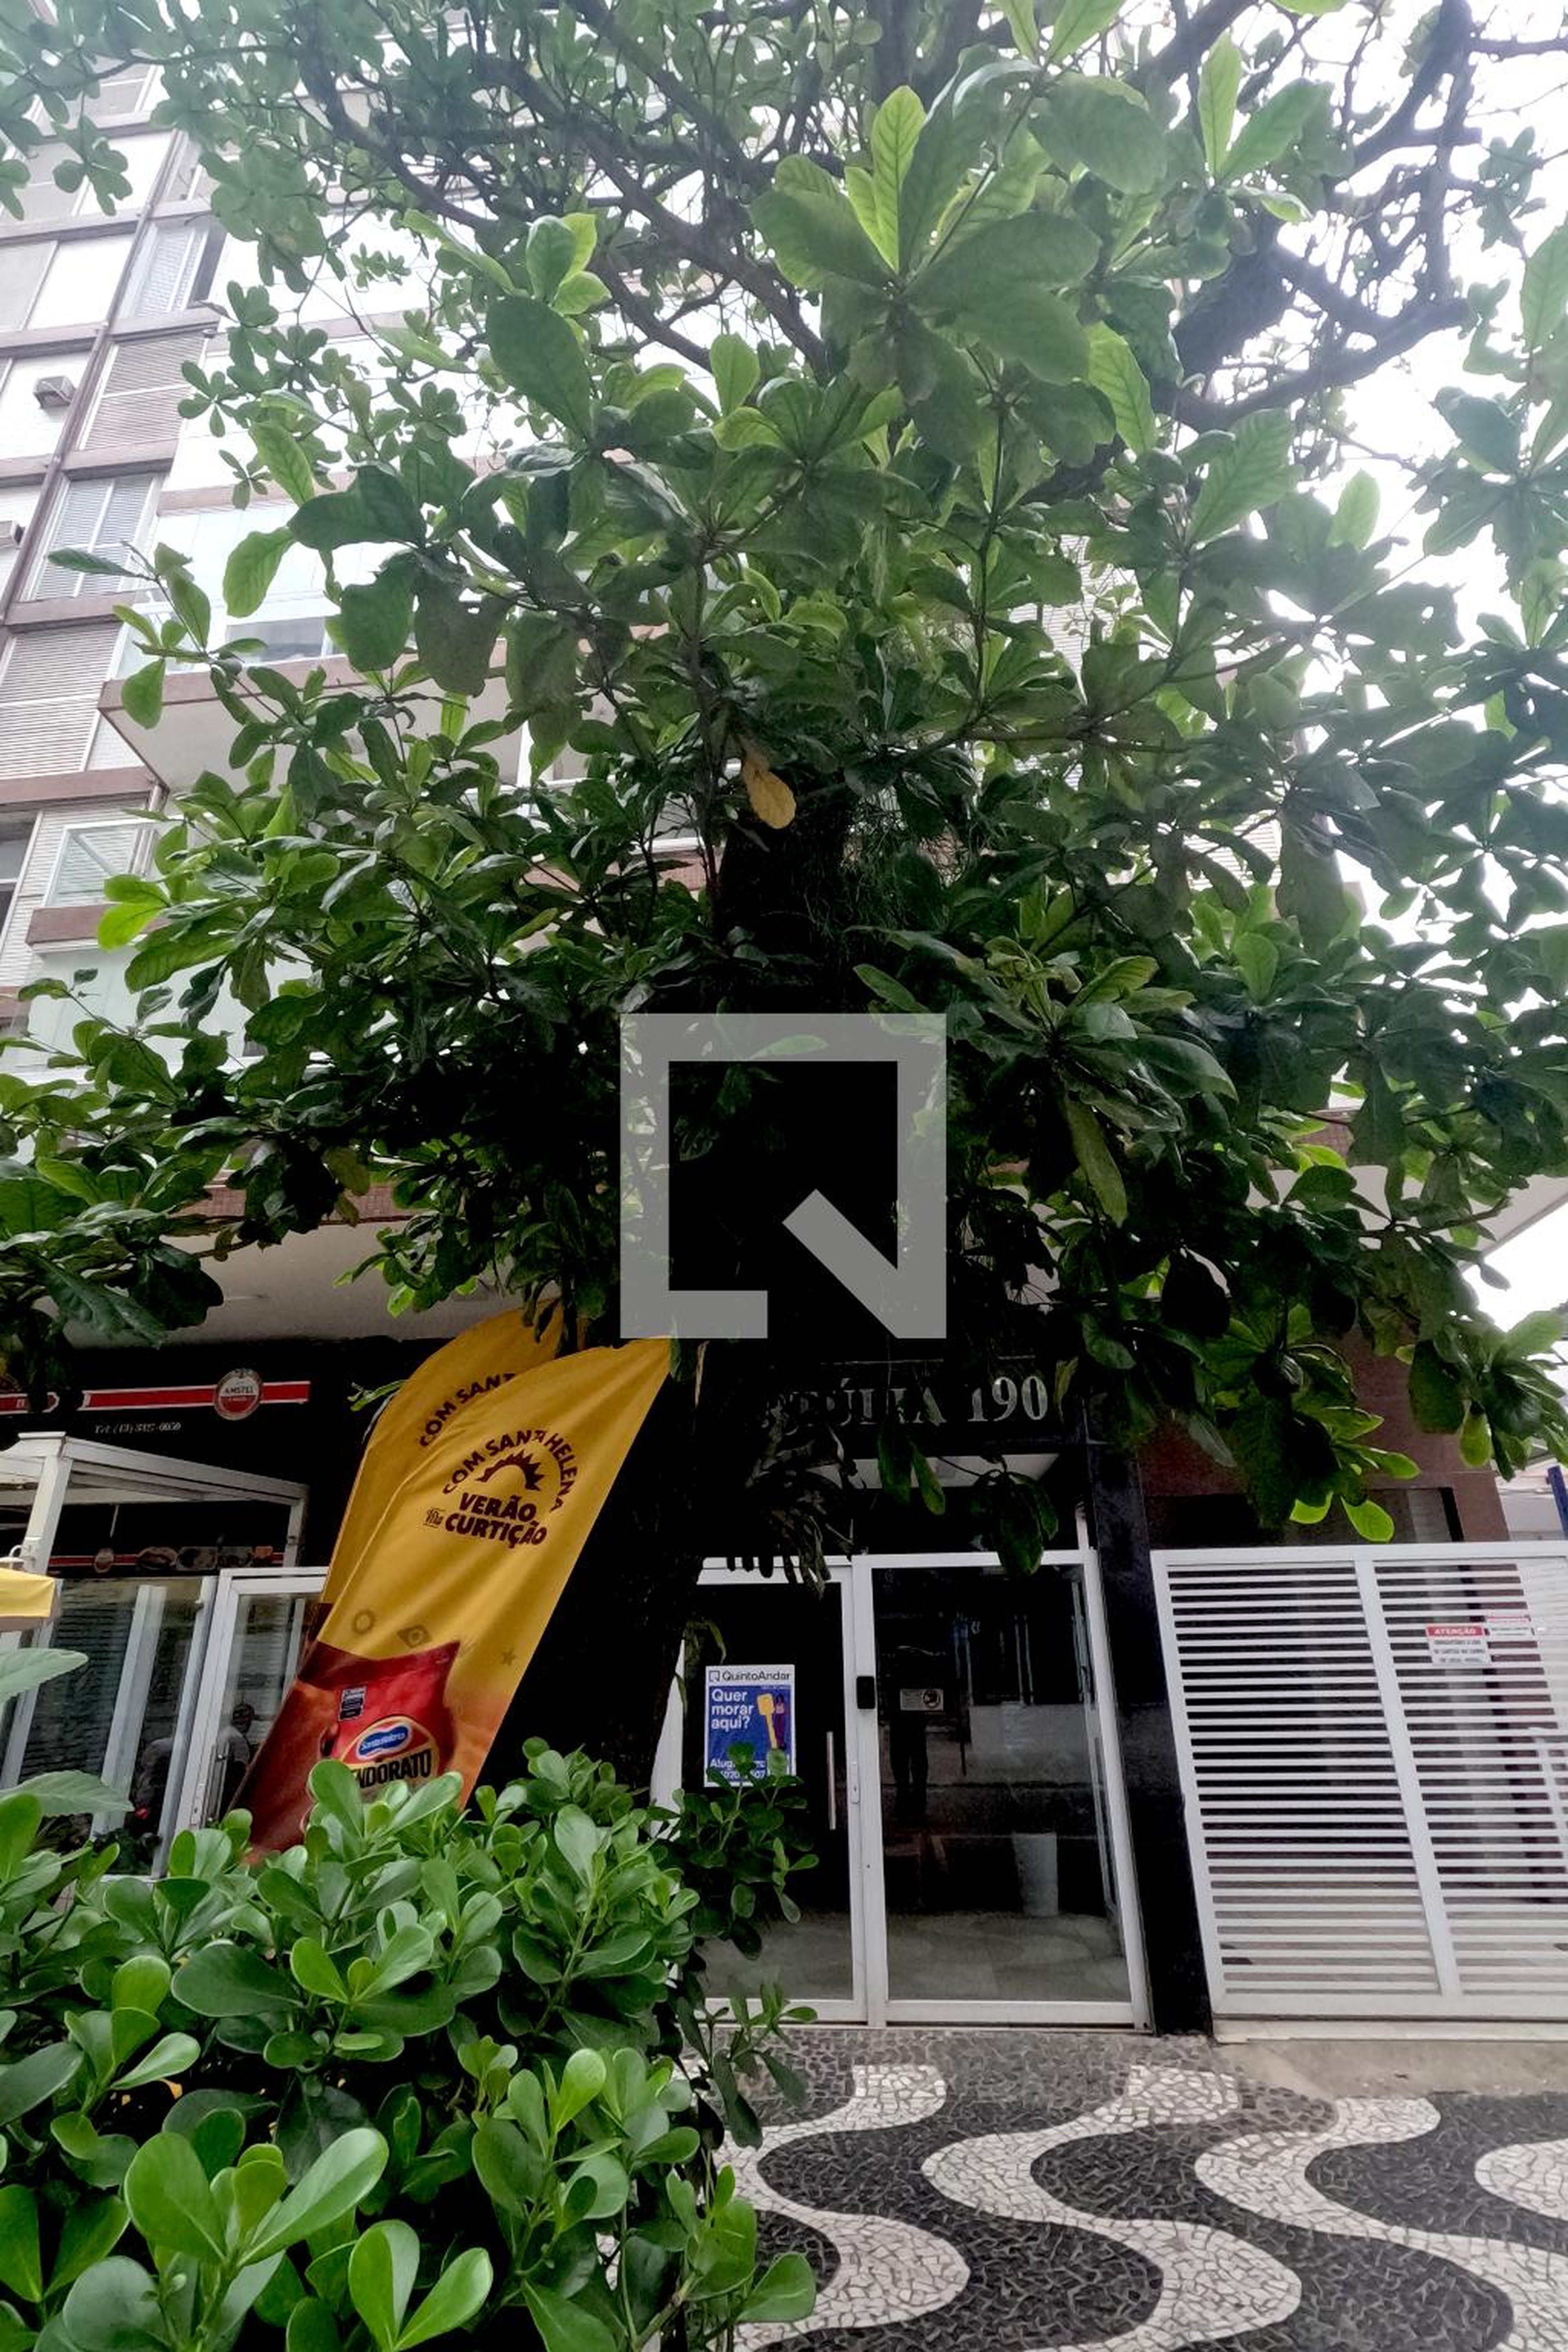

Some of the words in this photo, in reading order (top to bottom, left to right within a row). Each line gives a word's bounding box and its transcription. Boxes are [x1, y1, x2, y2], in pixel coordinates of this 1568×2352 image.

[966, 1375, 1049, 1422] 190
[419, 1401, 457, 1446] COM
[443, 1451, 486, 1494] COM
[544, 1433, 577, 1512] HELENA
[459, 1492, 537, 1522] VERÃO
[445, 1512, 547, 1548] CURTIÇÃO
[722, 1670, 790, 1681] QuintoAndar
[711, 1688, 748, 1702] Quer
[711, 1704, 755, 1715] morar
[711, 1715, 751, 1732] aqui?
[353, 1748, 432, 1788] NDORATO
